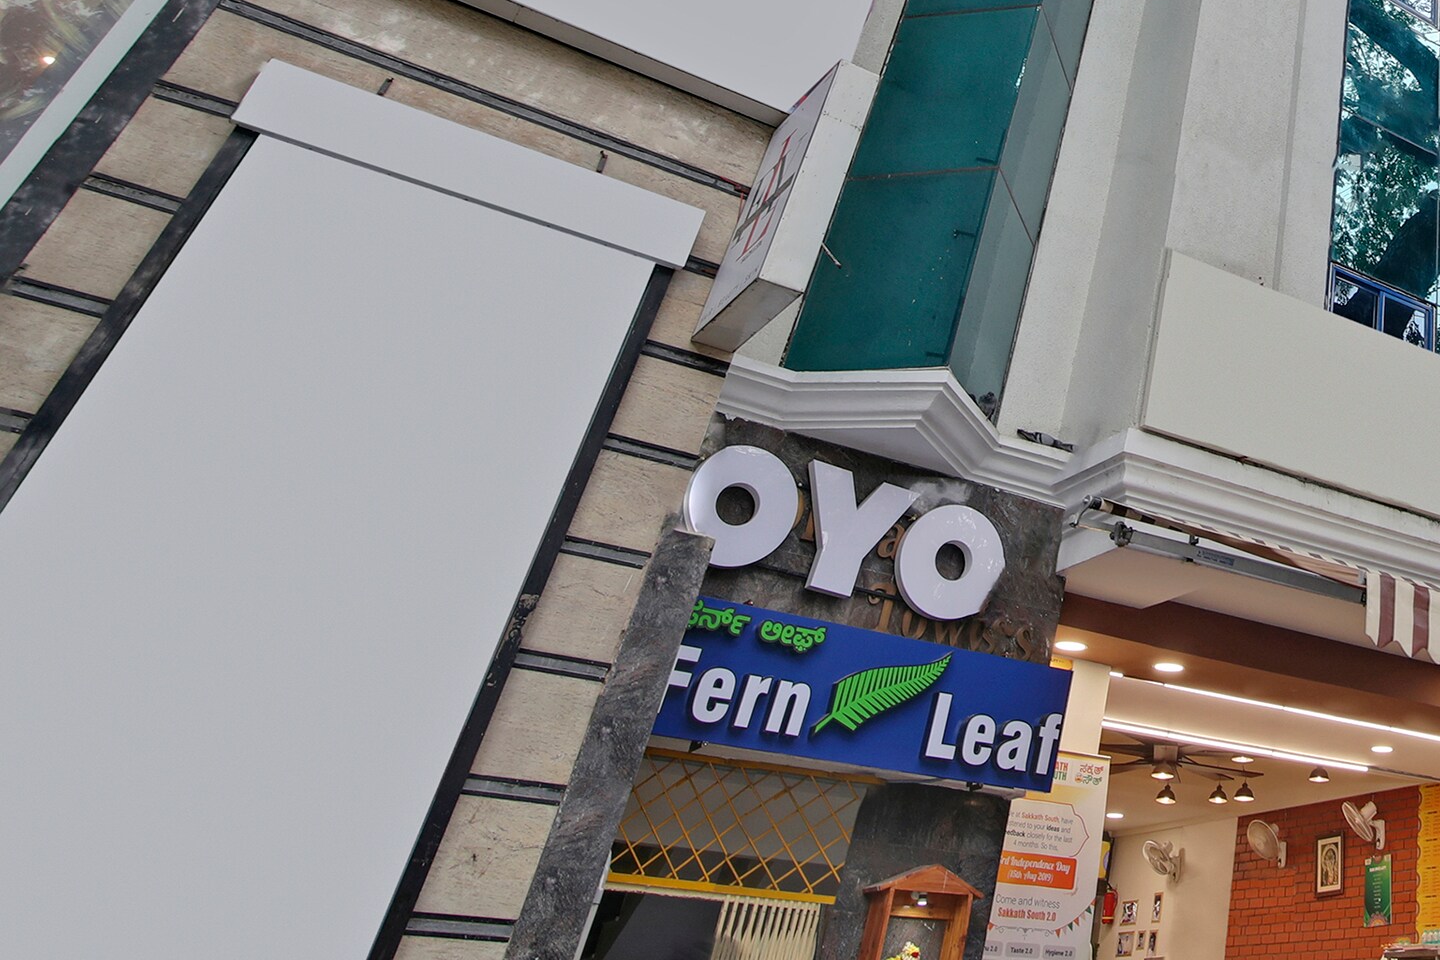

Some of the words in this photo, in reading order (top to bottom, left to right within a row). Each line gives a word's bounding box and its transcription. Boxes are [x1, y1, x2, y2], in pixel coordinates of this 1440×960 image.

[683, 444, 1005, 620] OYO
[658, 644, 812, 737] Fern
[925, 692, 1063, 776] Leaf
[1046, 825, 1060, 833] ideas
[1010, 856, 1054, 871] Independence
[1055, 861, 1071, 875] Day
[995, 893, 1017, 905] Come
[1018, 897, 1033, 907] and
[1034, 899, 1060, 909] witness
[998, 907, 1026, 918] Sakkath
[1027, 909, 1046, 920] South
[1046, 912, 1057, 922] 2.0
